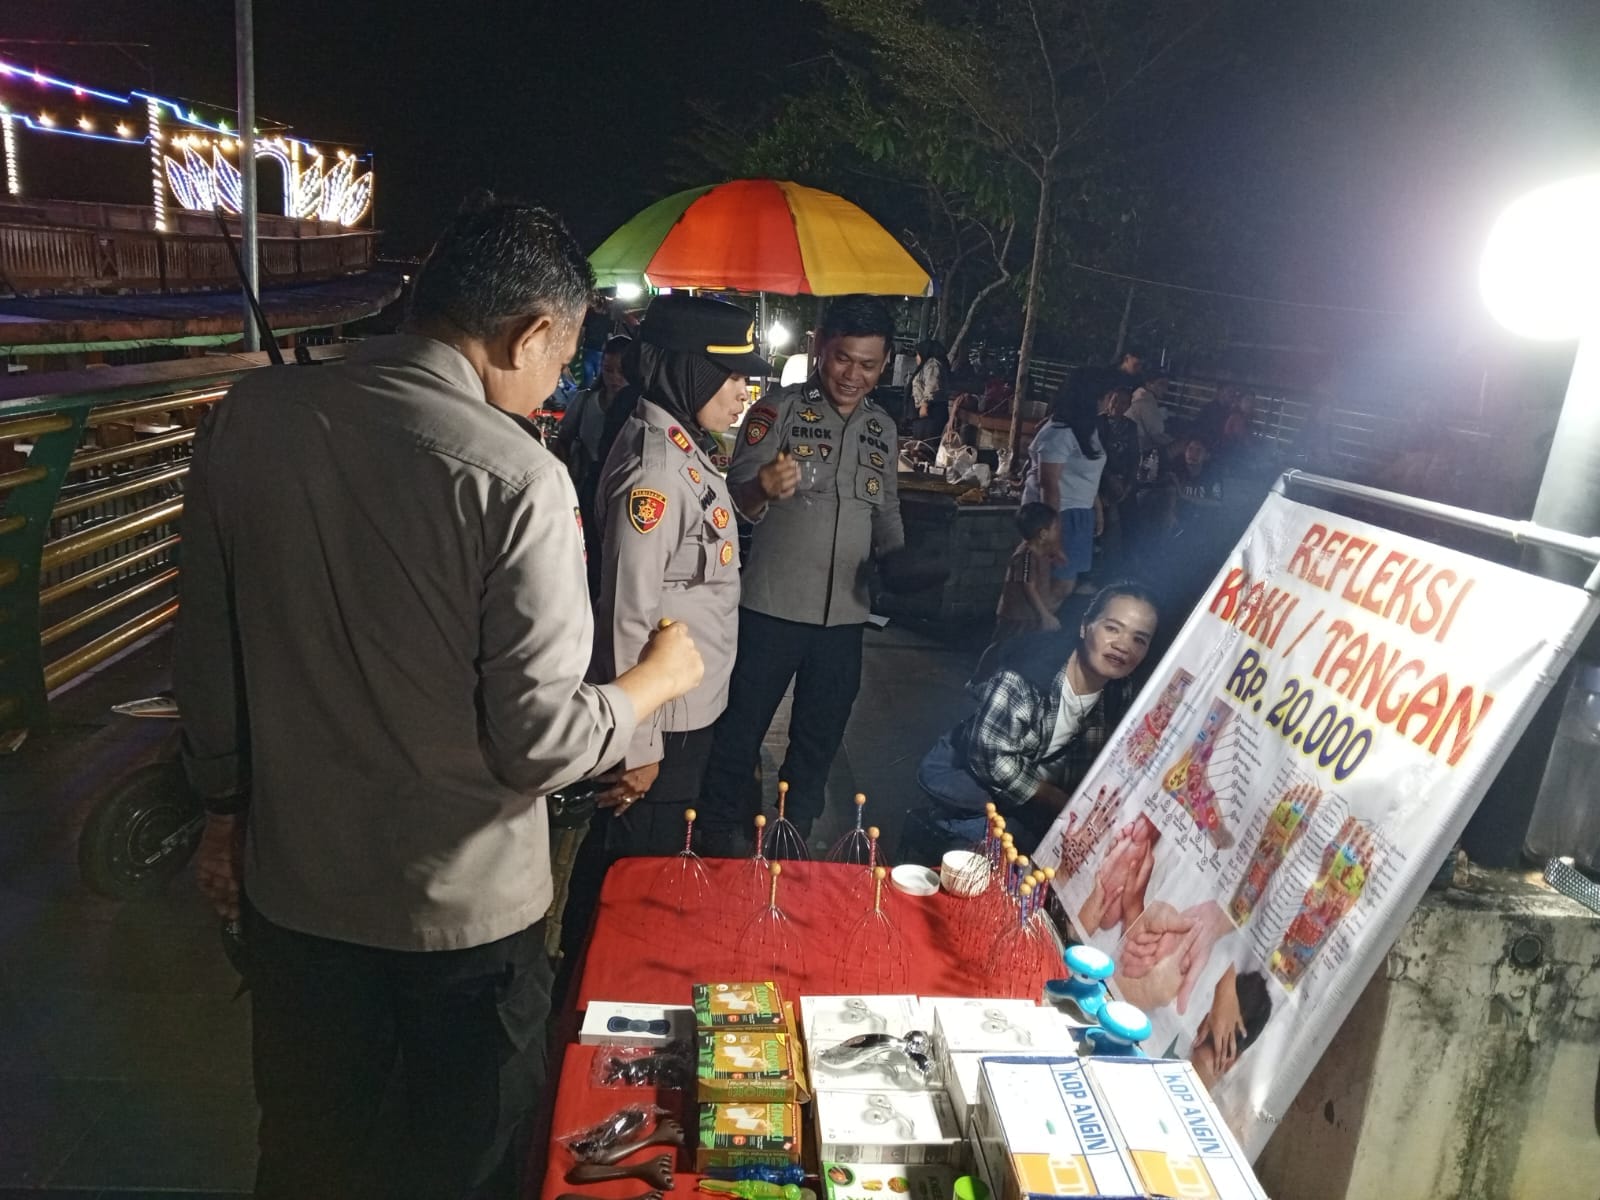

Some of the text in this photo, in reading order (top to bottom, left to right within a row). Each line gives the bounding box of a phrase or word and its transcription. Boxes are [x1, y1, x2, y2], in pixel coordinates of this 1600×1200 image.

[792, 426, 832, 440] ERICK
[1287, 524, 1476, 643] REFLEKSI
[1209, 568, 1300, 650] KAKI
[1312, 619, 1494, 766] TANGAN
[1225, 648, 1373, 781] RP. 20.000
[764, 1039, 780, 1076] KINOKI
[1058, 1071, 1110, 1151] KOP ANGIN
[1162, 1074, 1224, 1154] KOP ANGIN
